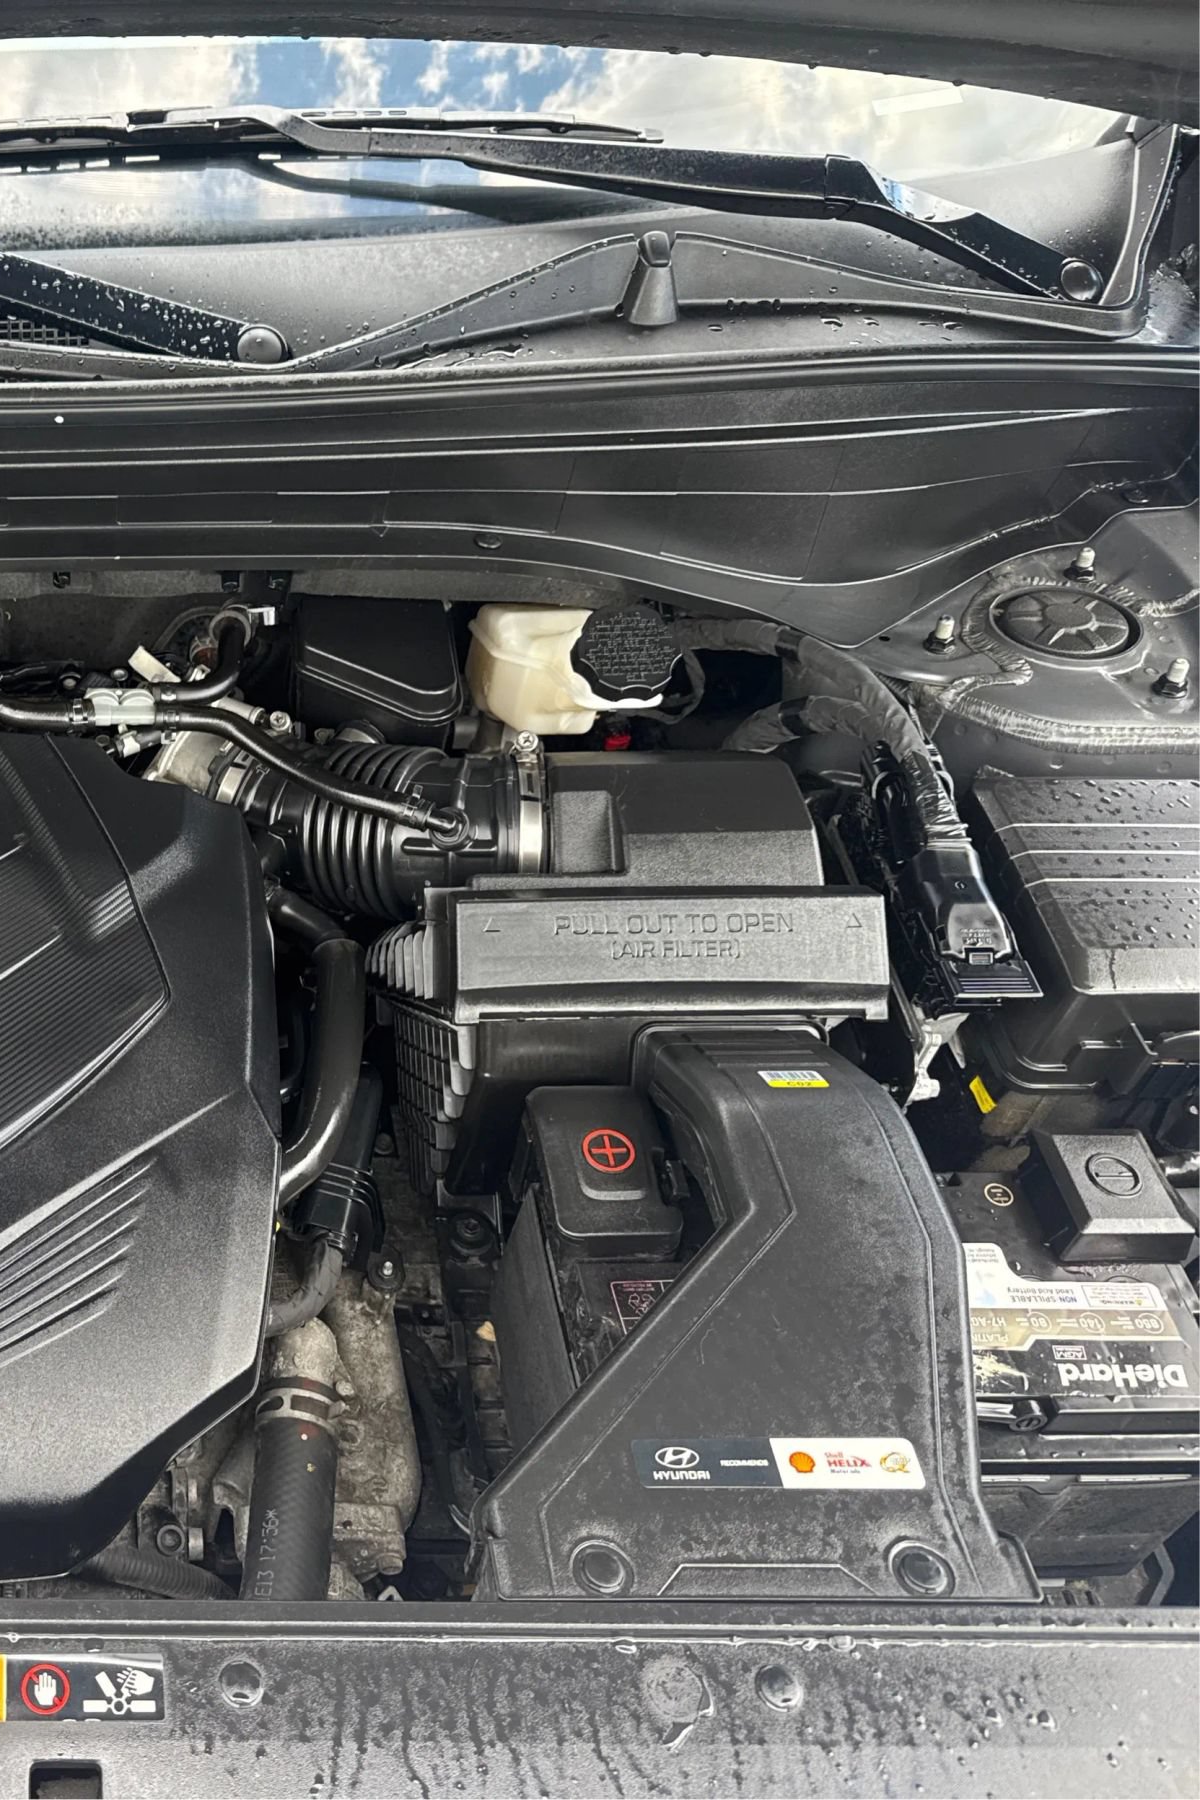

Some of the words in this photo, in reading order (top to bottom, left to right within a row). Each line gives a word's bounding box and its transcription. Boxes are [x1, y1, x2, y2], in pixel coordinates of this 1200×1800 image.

[554, 914, 619, 935] PULL
[626, 913, 678, 934] OUT
[685, 912, 718, 934] TO
[726, 912, 794, 933] OPEN
[1007, 1286, 1037, 1294] Battery
[1053, 1287, 1075, 1295] Lead
[1080, 1317, 1101, 1329] 140
[1057, 1363, 1189, 1388] DieHard
[825, 1451, 843, 1459] Shell
[827, 1457, 872, 1468] HELIX
[653, 1470, 710, 1481] HYUNDAI
